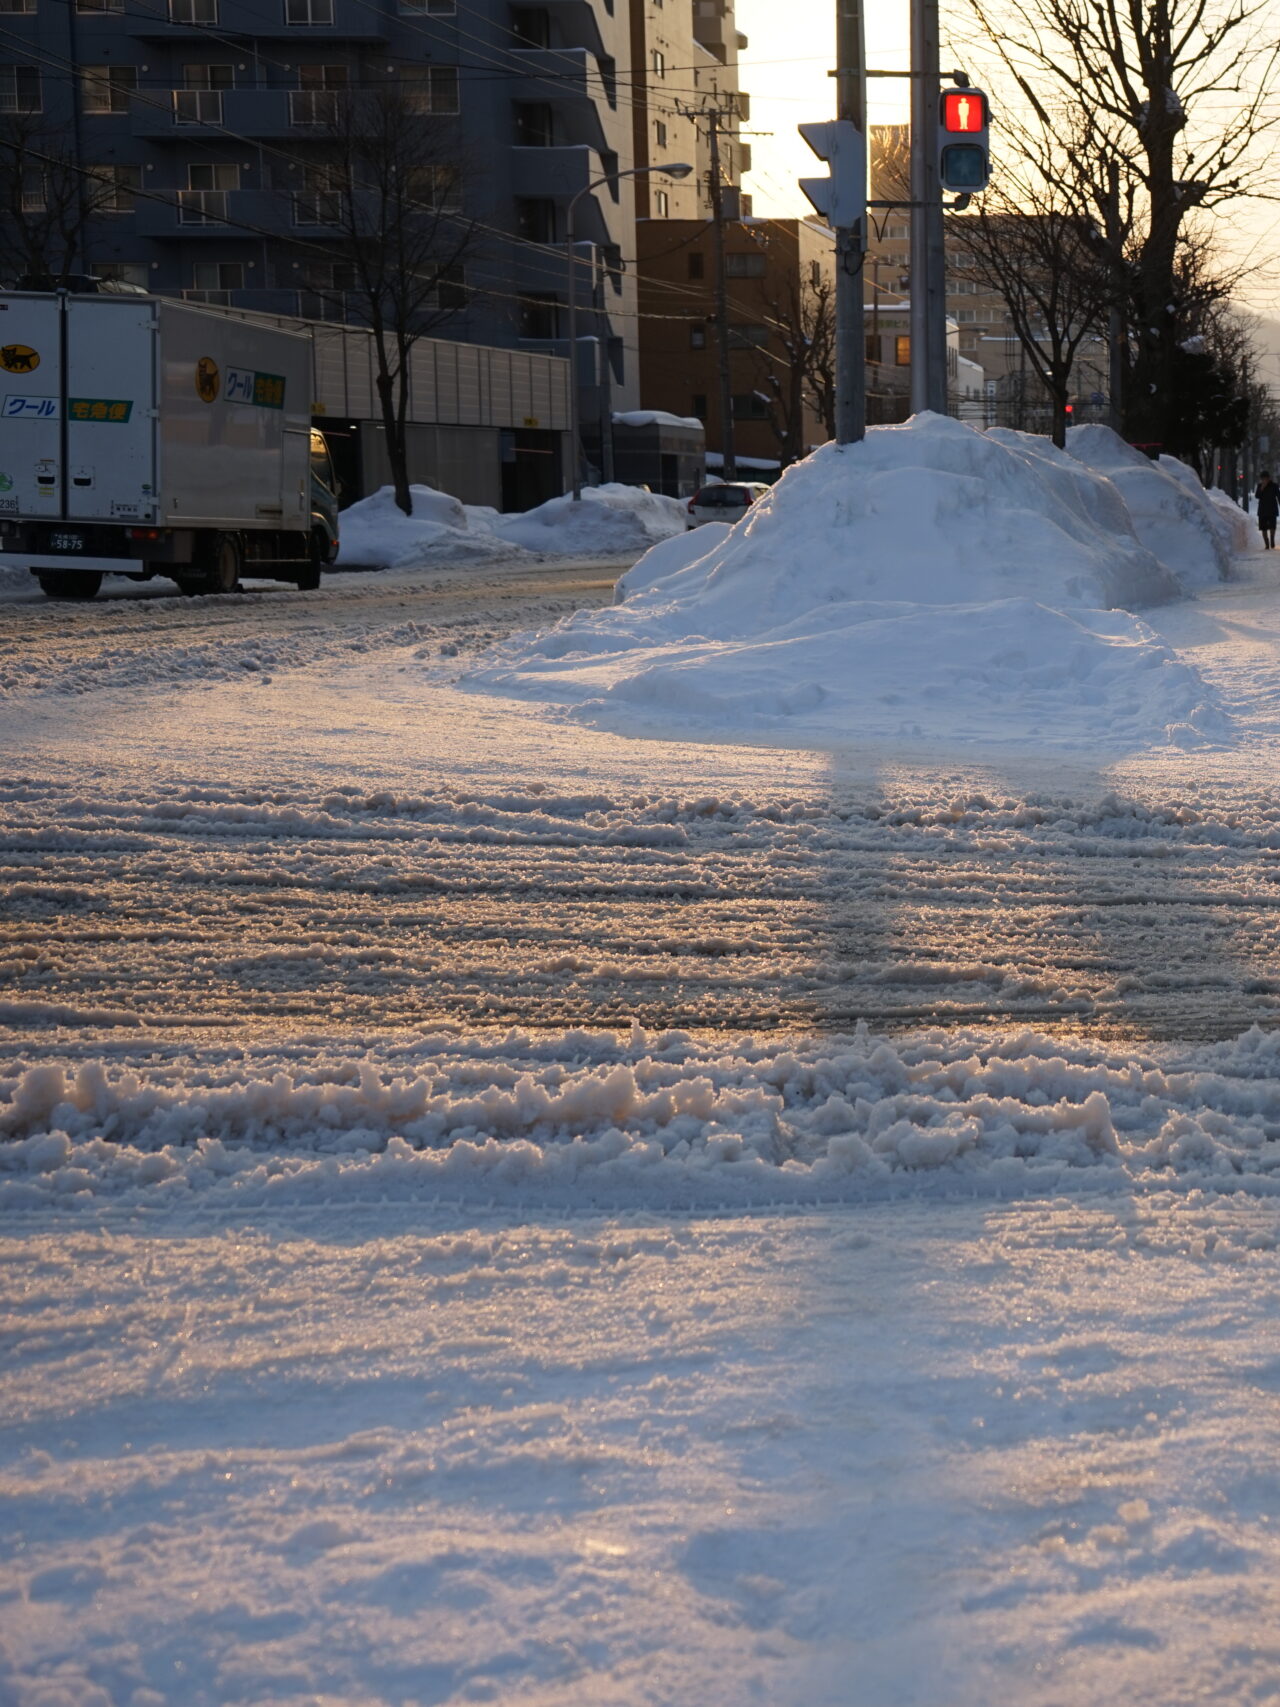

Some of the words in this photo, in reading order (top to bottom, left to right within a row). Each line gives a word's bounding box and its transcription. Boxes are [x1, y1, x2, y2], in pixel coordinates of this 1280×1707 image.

[228, 373, 252, 399] クール
[9, 399, 55, 416] クール
[72, 402, 128, 419] 宅急便
[56, 539, 83, 549] 58-75
